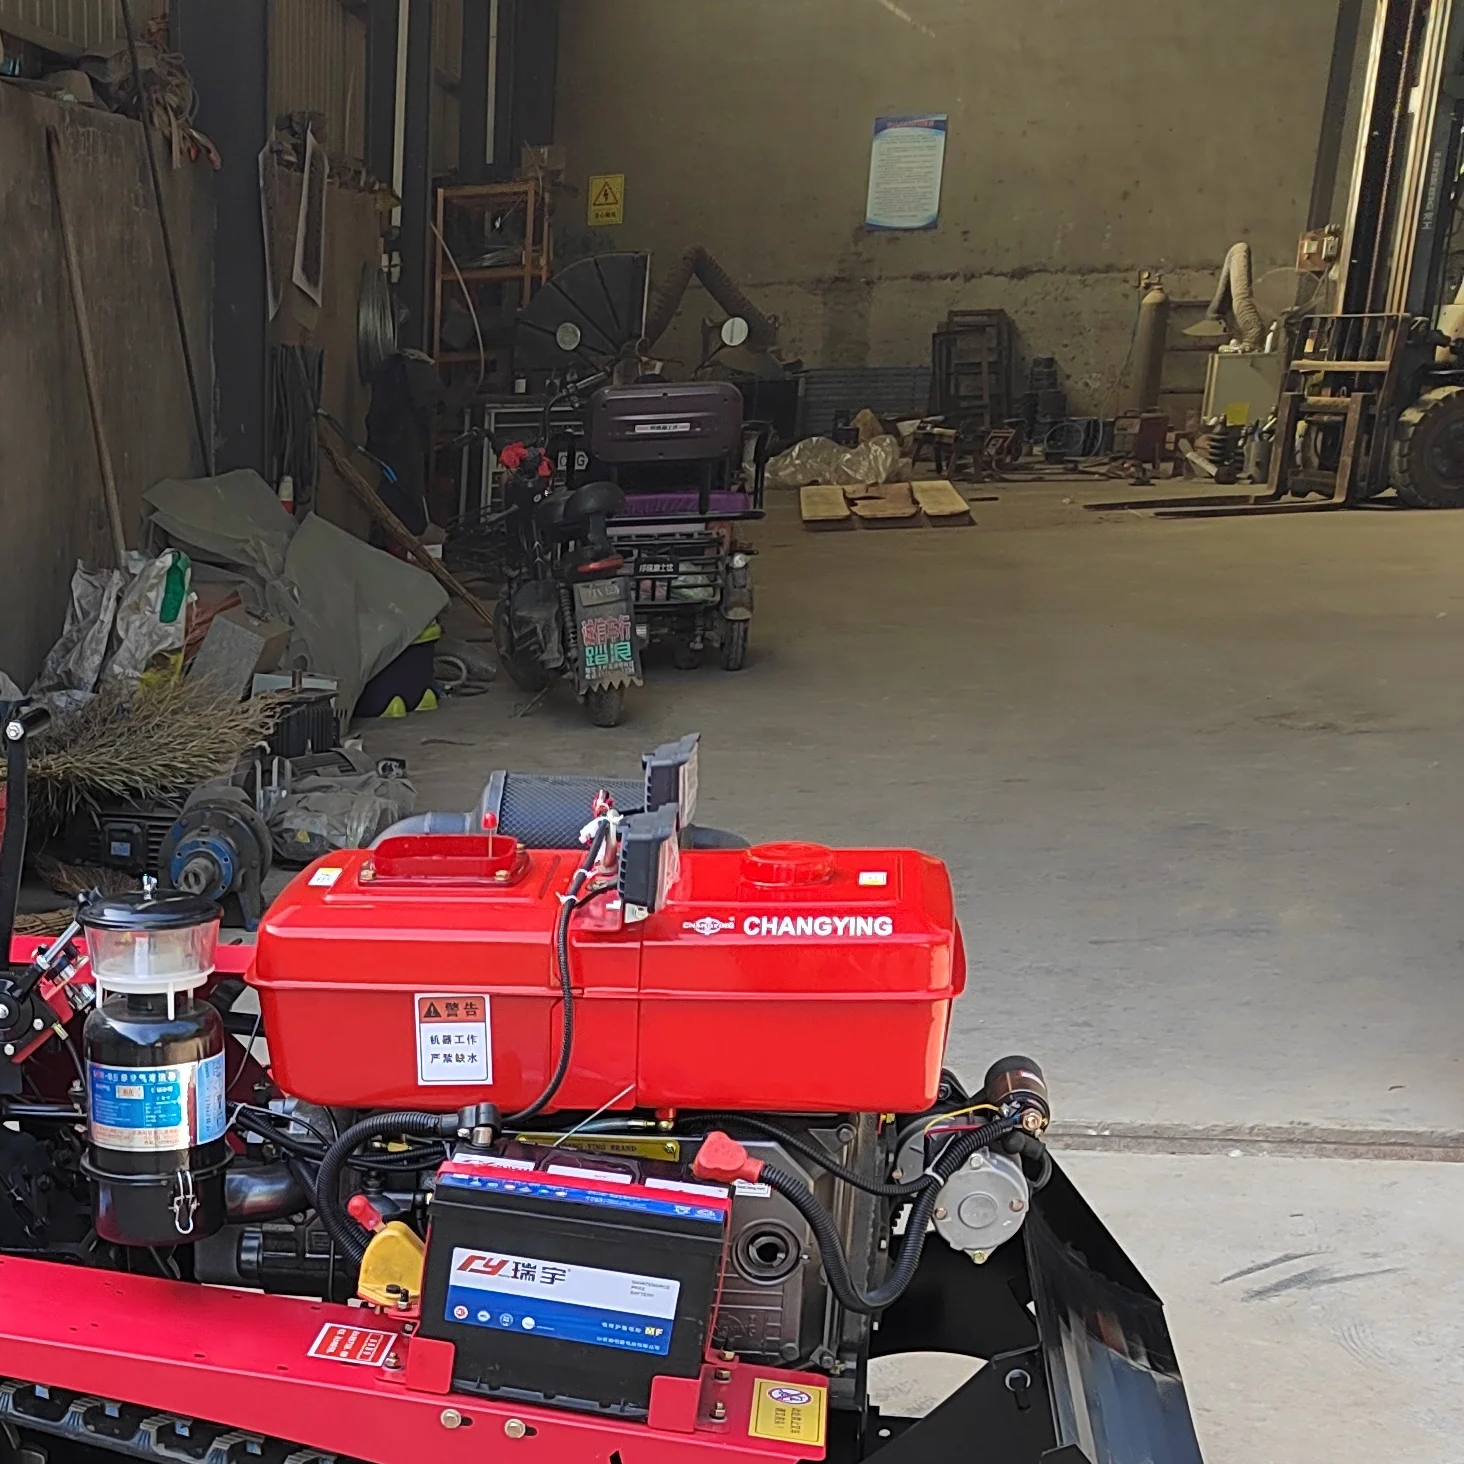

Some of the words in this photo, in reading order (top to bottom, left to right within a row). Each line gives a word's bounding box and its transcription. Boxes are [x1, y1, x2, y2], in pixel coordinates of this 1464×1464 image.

[743, 915, 893, 937] CHANGYING
[445, 1001, 479, 1018] 警告
[430, 1034, 479, 1045] 机器工作
[430, 1052, 479, 1064] 严禁缺水
[511, 1260, 567, 1285] 瑞宇
[644, 1326, 664, 1336] MF
